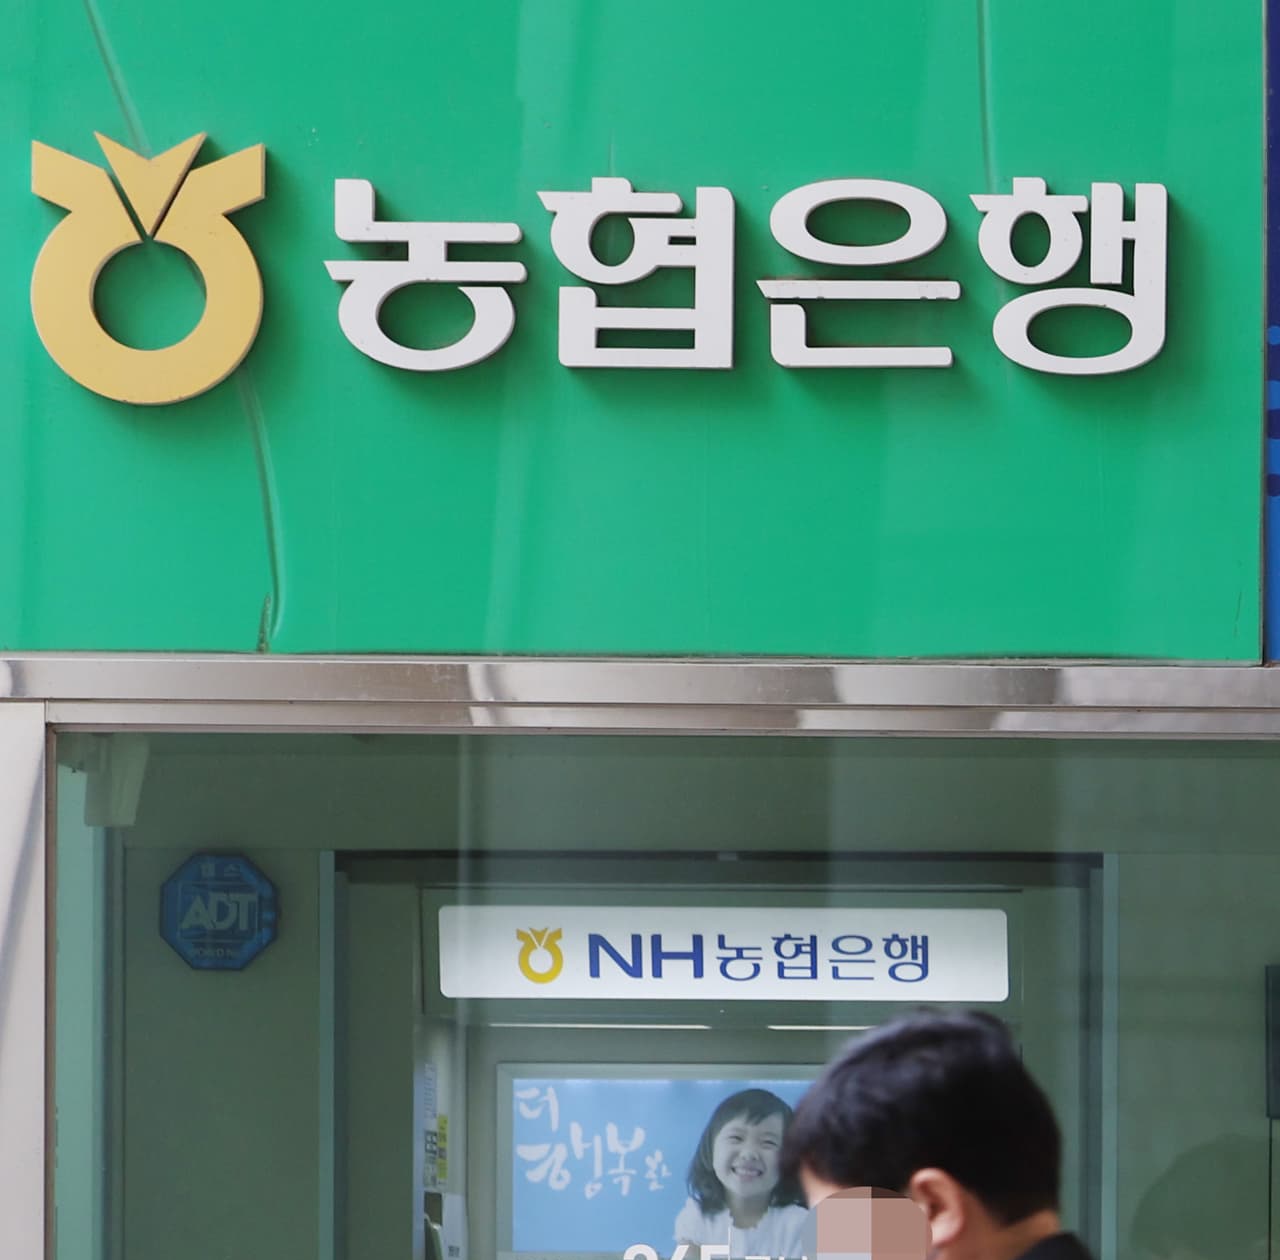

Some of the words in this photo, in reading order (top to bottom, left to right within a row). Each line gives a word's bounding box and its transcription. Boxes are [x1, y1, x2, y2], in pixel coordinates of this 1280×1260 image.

[323, 177, 1168, 376] 농협은행
[181, 891, 256, 931] ADT
[588, 933, 929, 983] NH농협은행
[515, 1085, 560, 1133] 더
